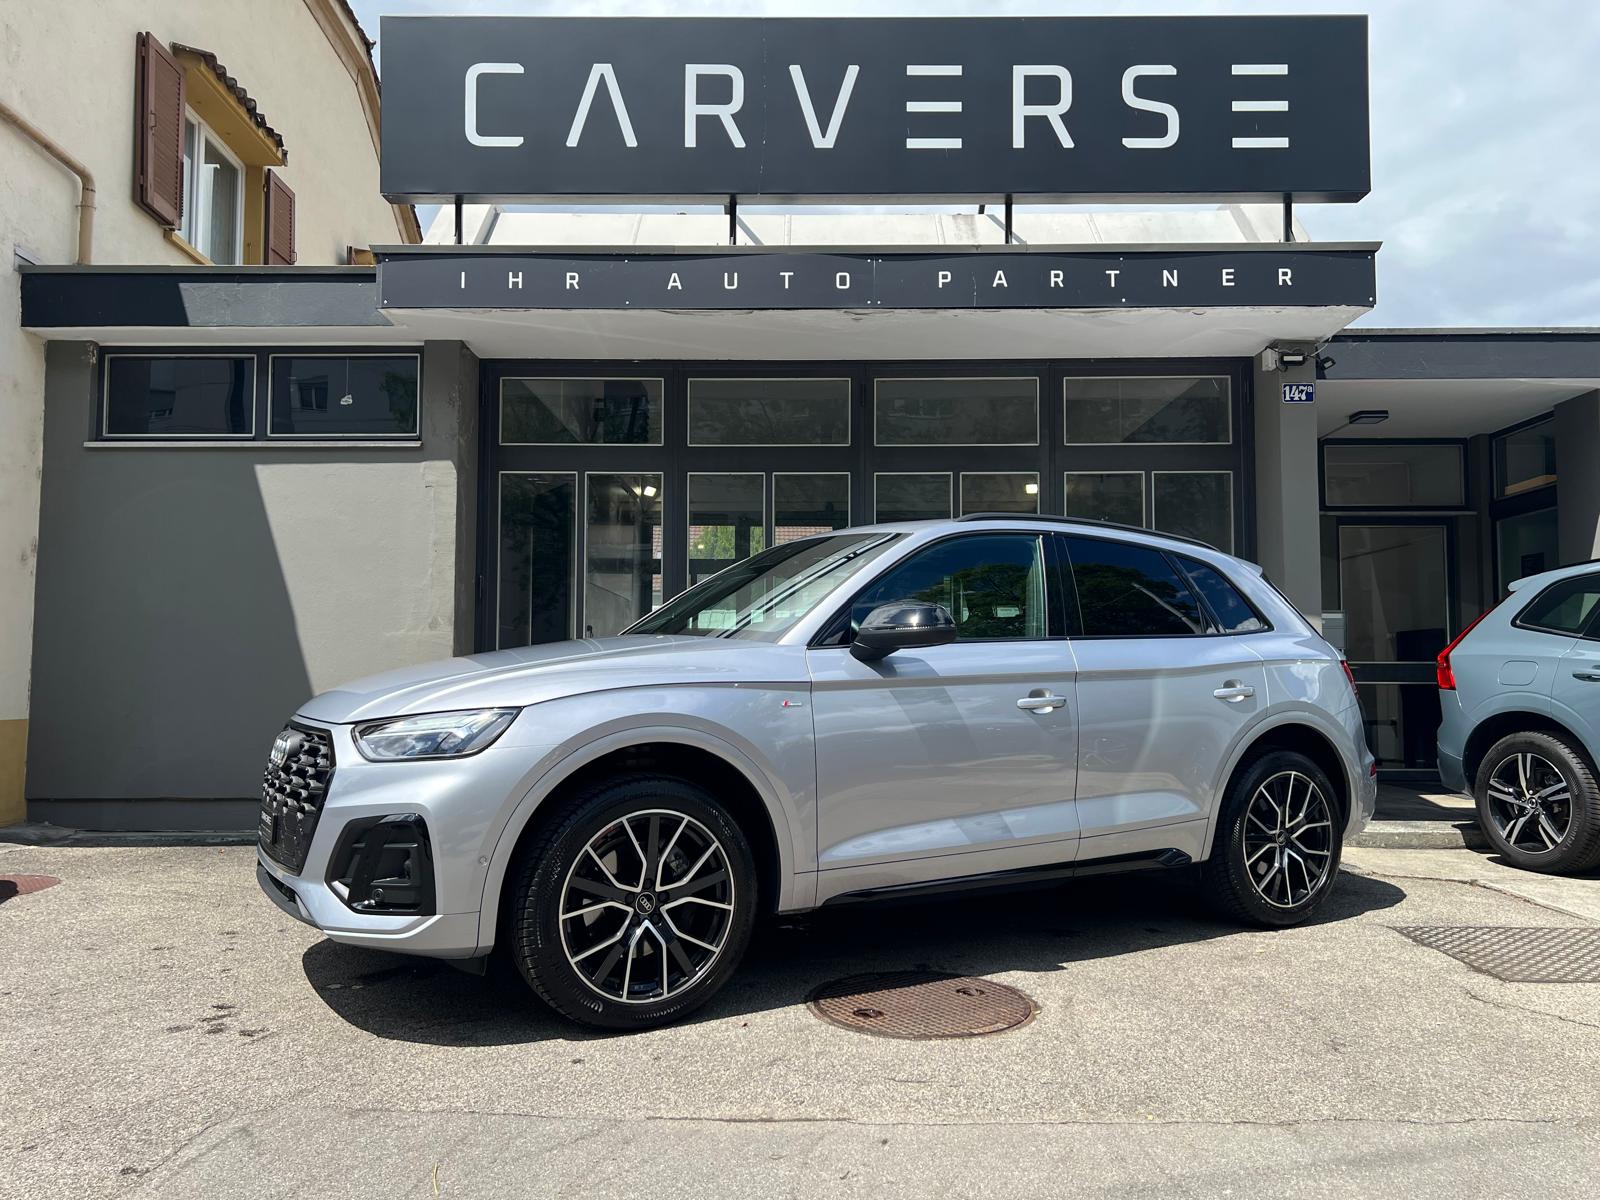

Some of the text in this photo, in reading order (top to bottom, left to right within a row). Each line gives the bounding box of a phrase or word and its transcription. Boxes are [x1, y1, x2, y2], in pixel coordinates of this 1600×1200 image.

[464, 62, 1290, 150] CARVERSE
[460, 269, 1293, 290] IHR AUTO PARTNER
